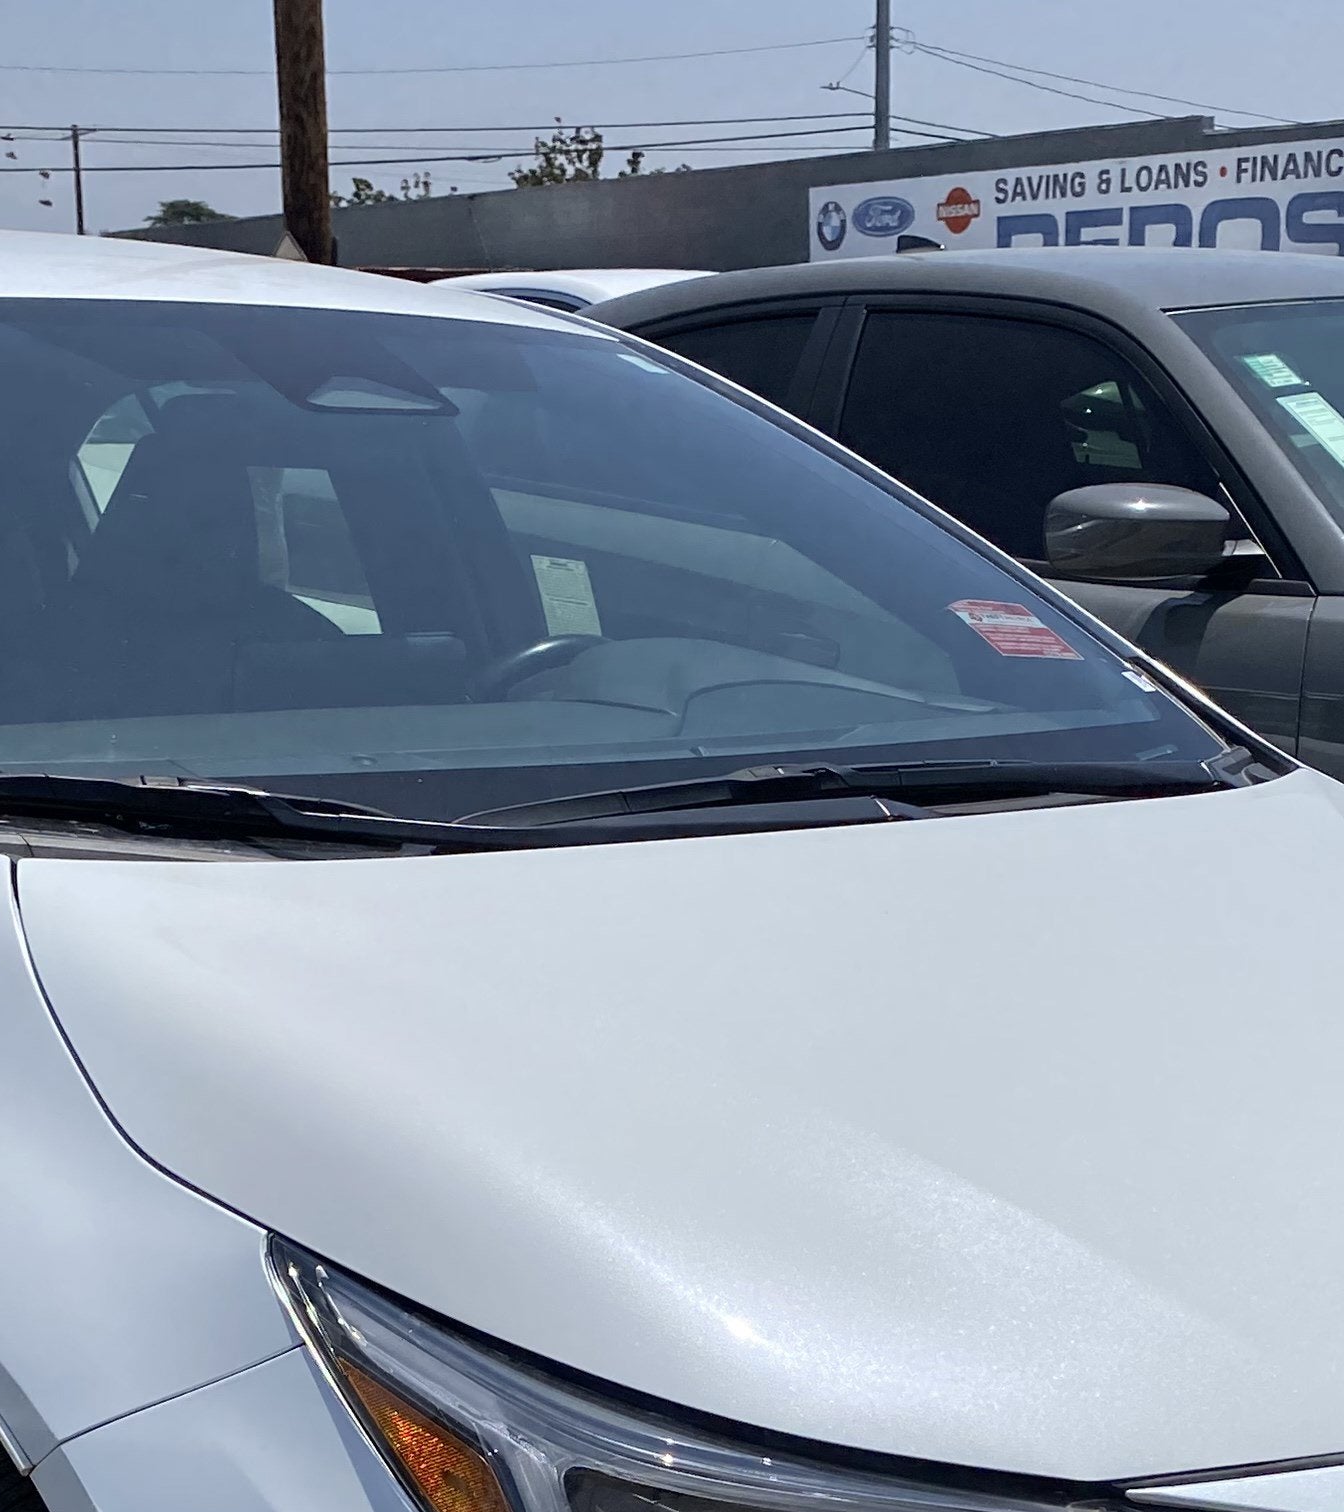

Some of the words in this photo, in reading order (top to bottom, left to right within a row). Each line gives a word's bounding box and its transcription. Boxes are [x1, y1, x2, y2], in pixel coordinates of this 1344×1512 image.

[994, 171, 1086, 204] SAVING
[1096, 169, 1111, 195] &
[1120, 160, 1208, 193] LOANS
[937, 201, 980, 219] NISSAN
